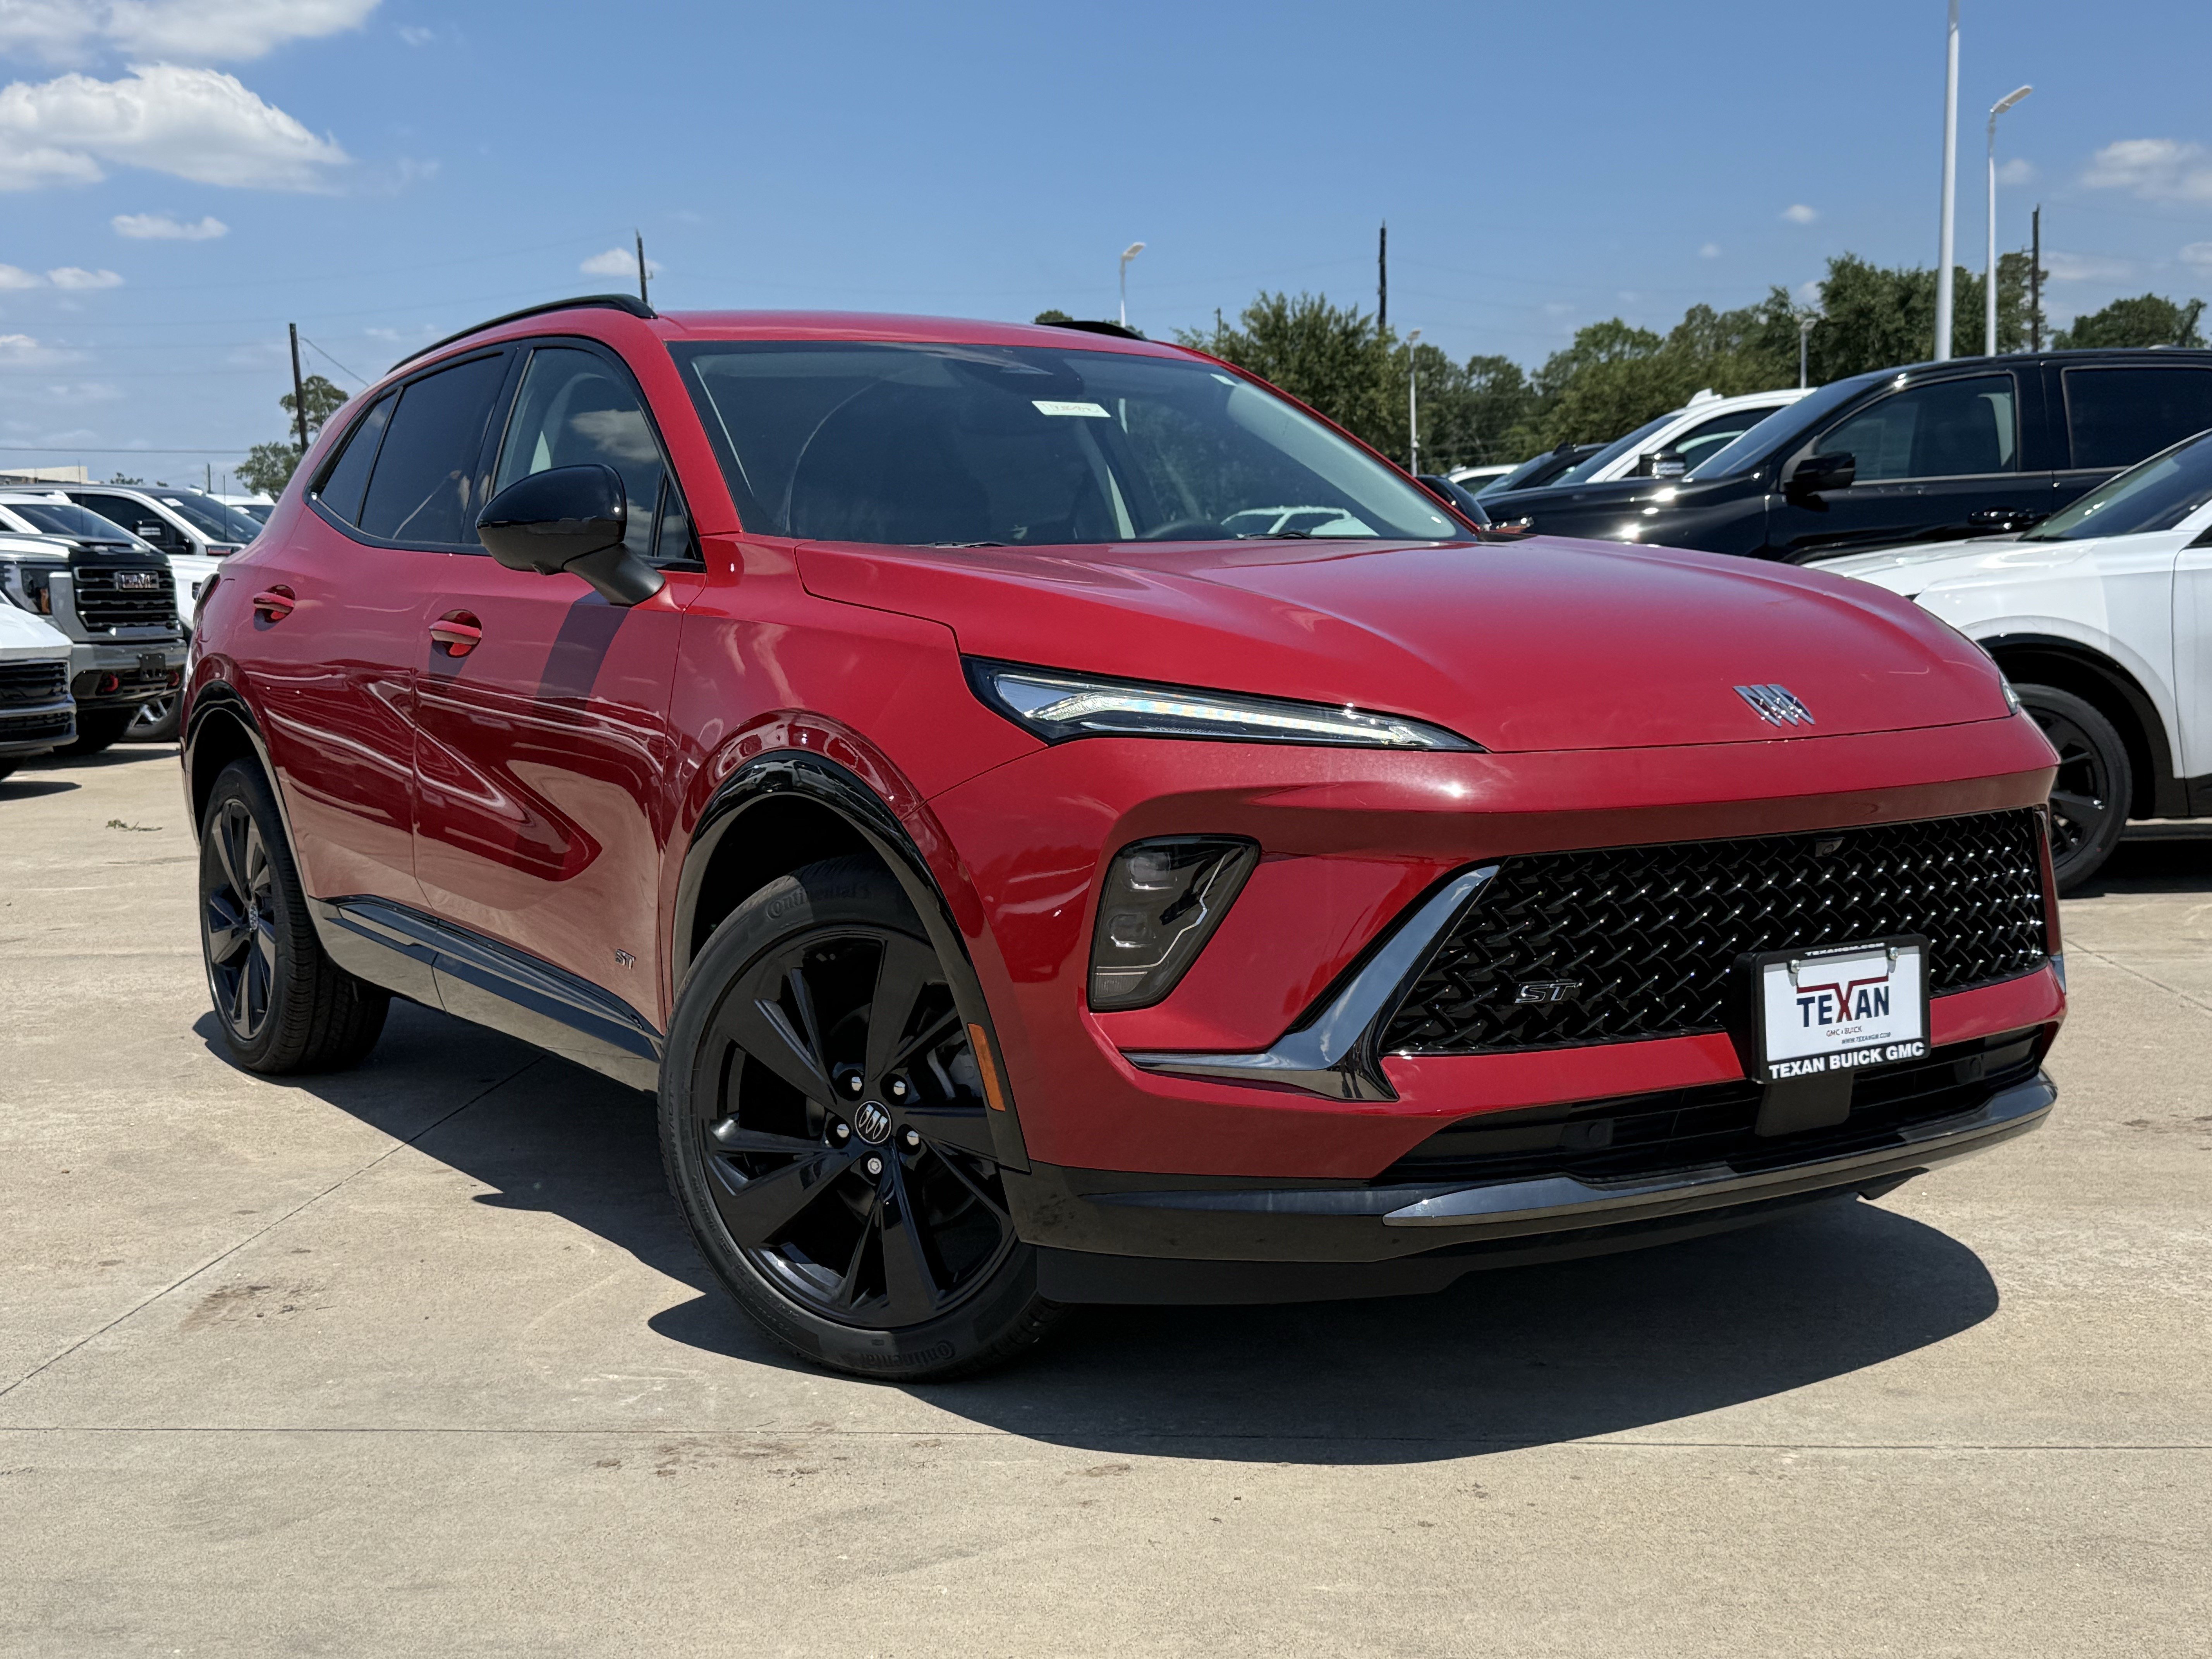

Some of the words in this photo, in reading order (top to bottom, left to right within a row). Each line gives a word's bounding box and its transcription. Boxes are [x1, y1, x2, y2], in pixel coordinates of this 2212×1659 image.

[615, 948, 636, 970] ST
[1515, 982, 1577, 1003] ST
[1796, 976, 1889, 1027] TEXAN
[1826, 1029, 1840, 1037] GMC
[1769, 1057, 1825, 1079] TEXAN
[1829, 1048, 1884, 1070] BUICK
[1886, 1041, 1925, 1060] GMC
